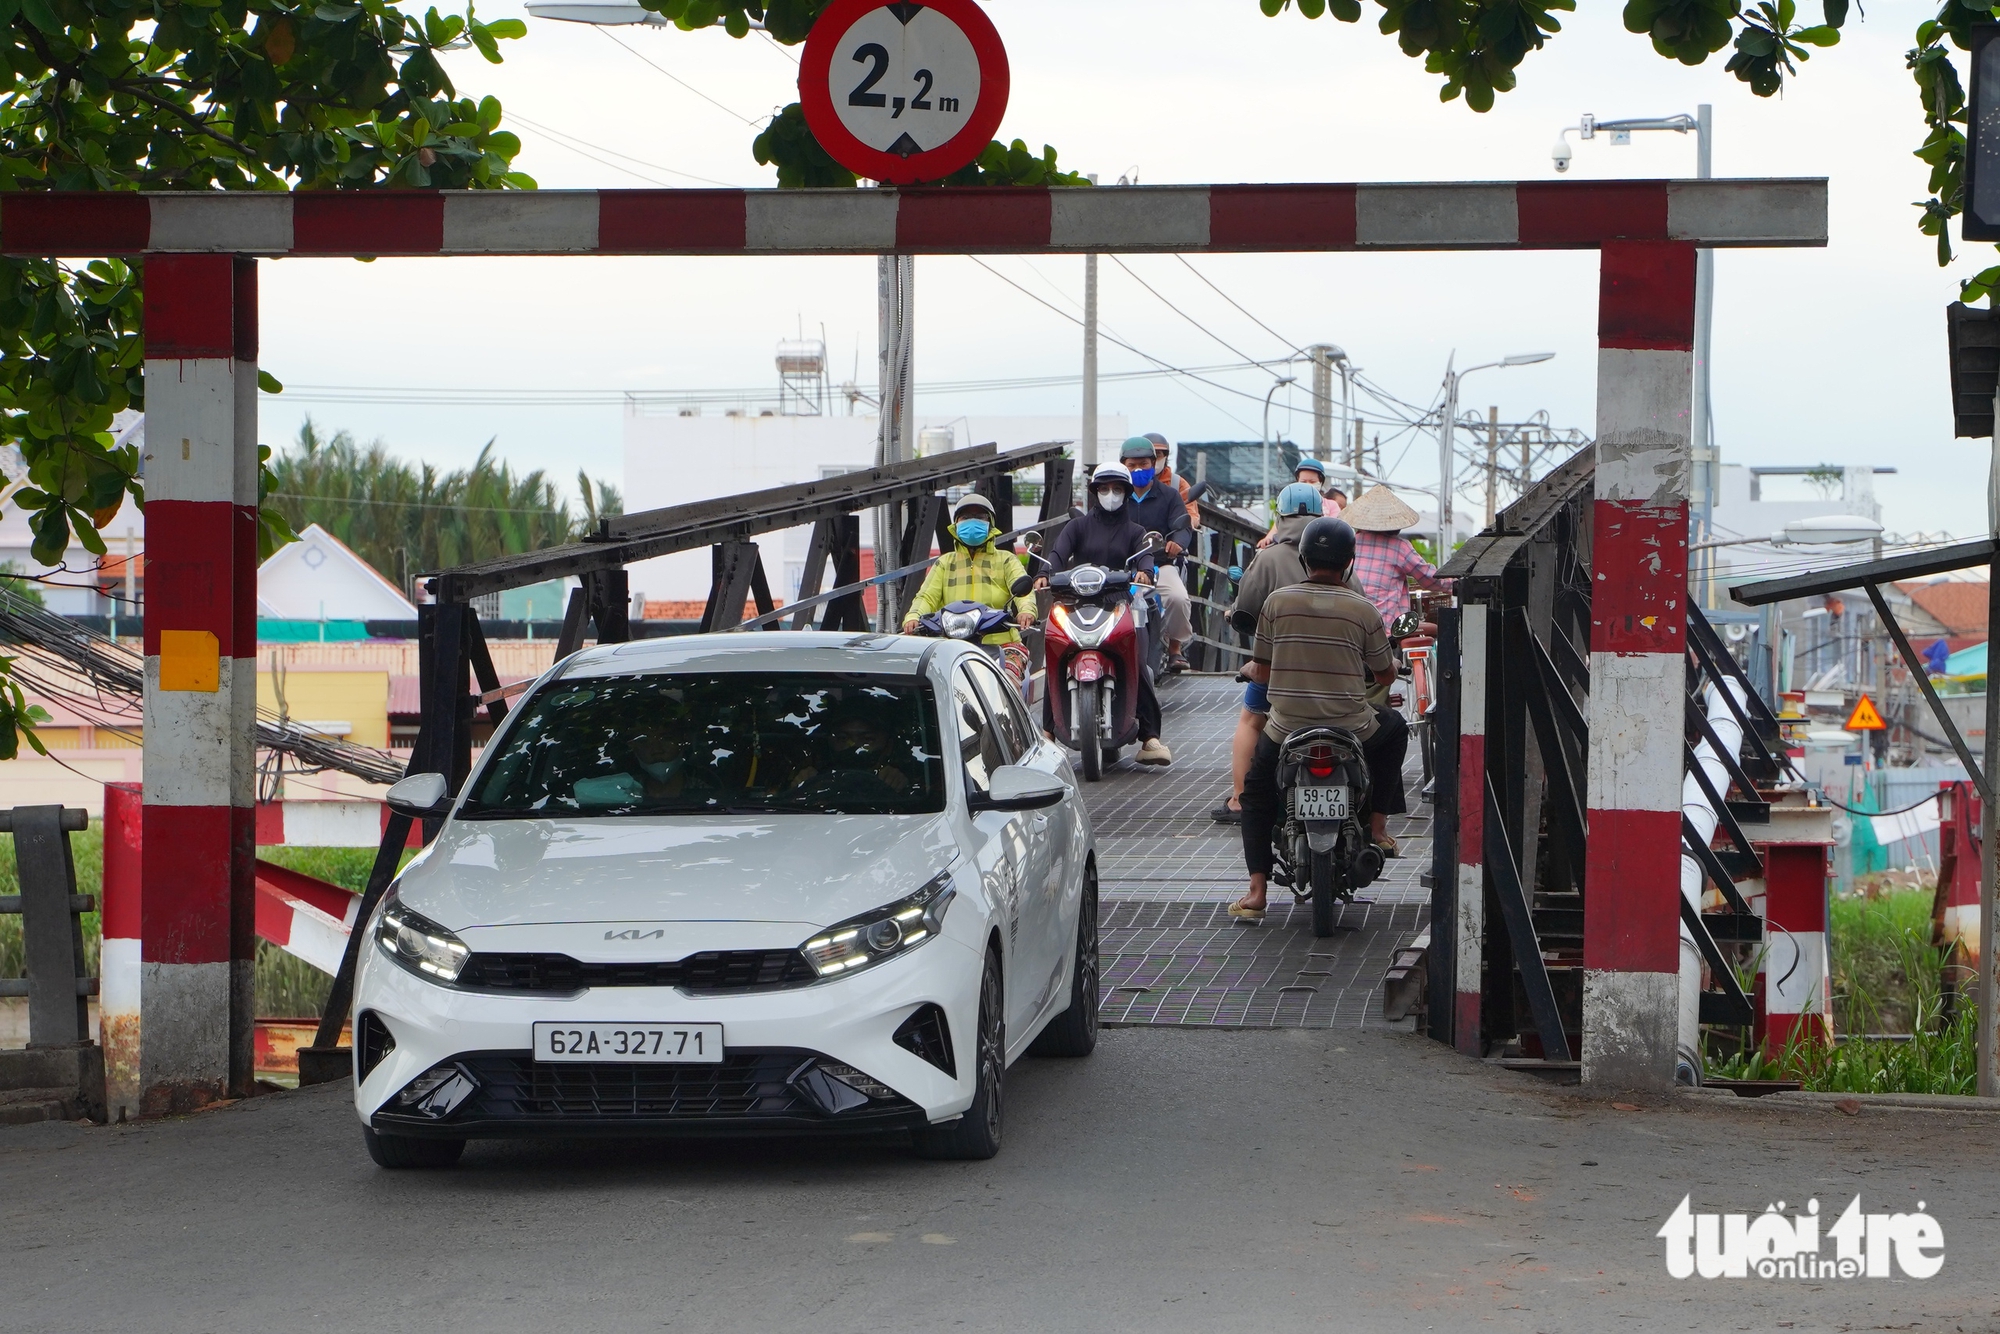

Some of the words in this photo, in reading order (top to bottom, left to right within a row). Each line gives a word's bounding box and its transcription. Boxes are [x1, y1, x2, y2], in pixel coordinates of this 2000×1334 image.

[1304, 789, 1340, 802] 59-C2
[1299, 804, 1345, 818] 444.60
[604, 929, 665, 940] KIA
[550, 1030, 703, 1055] 62A-327.71
